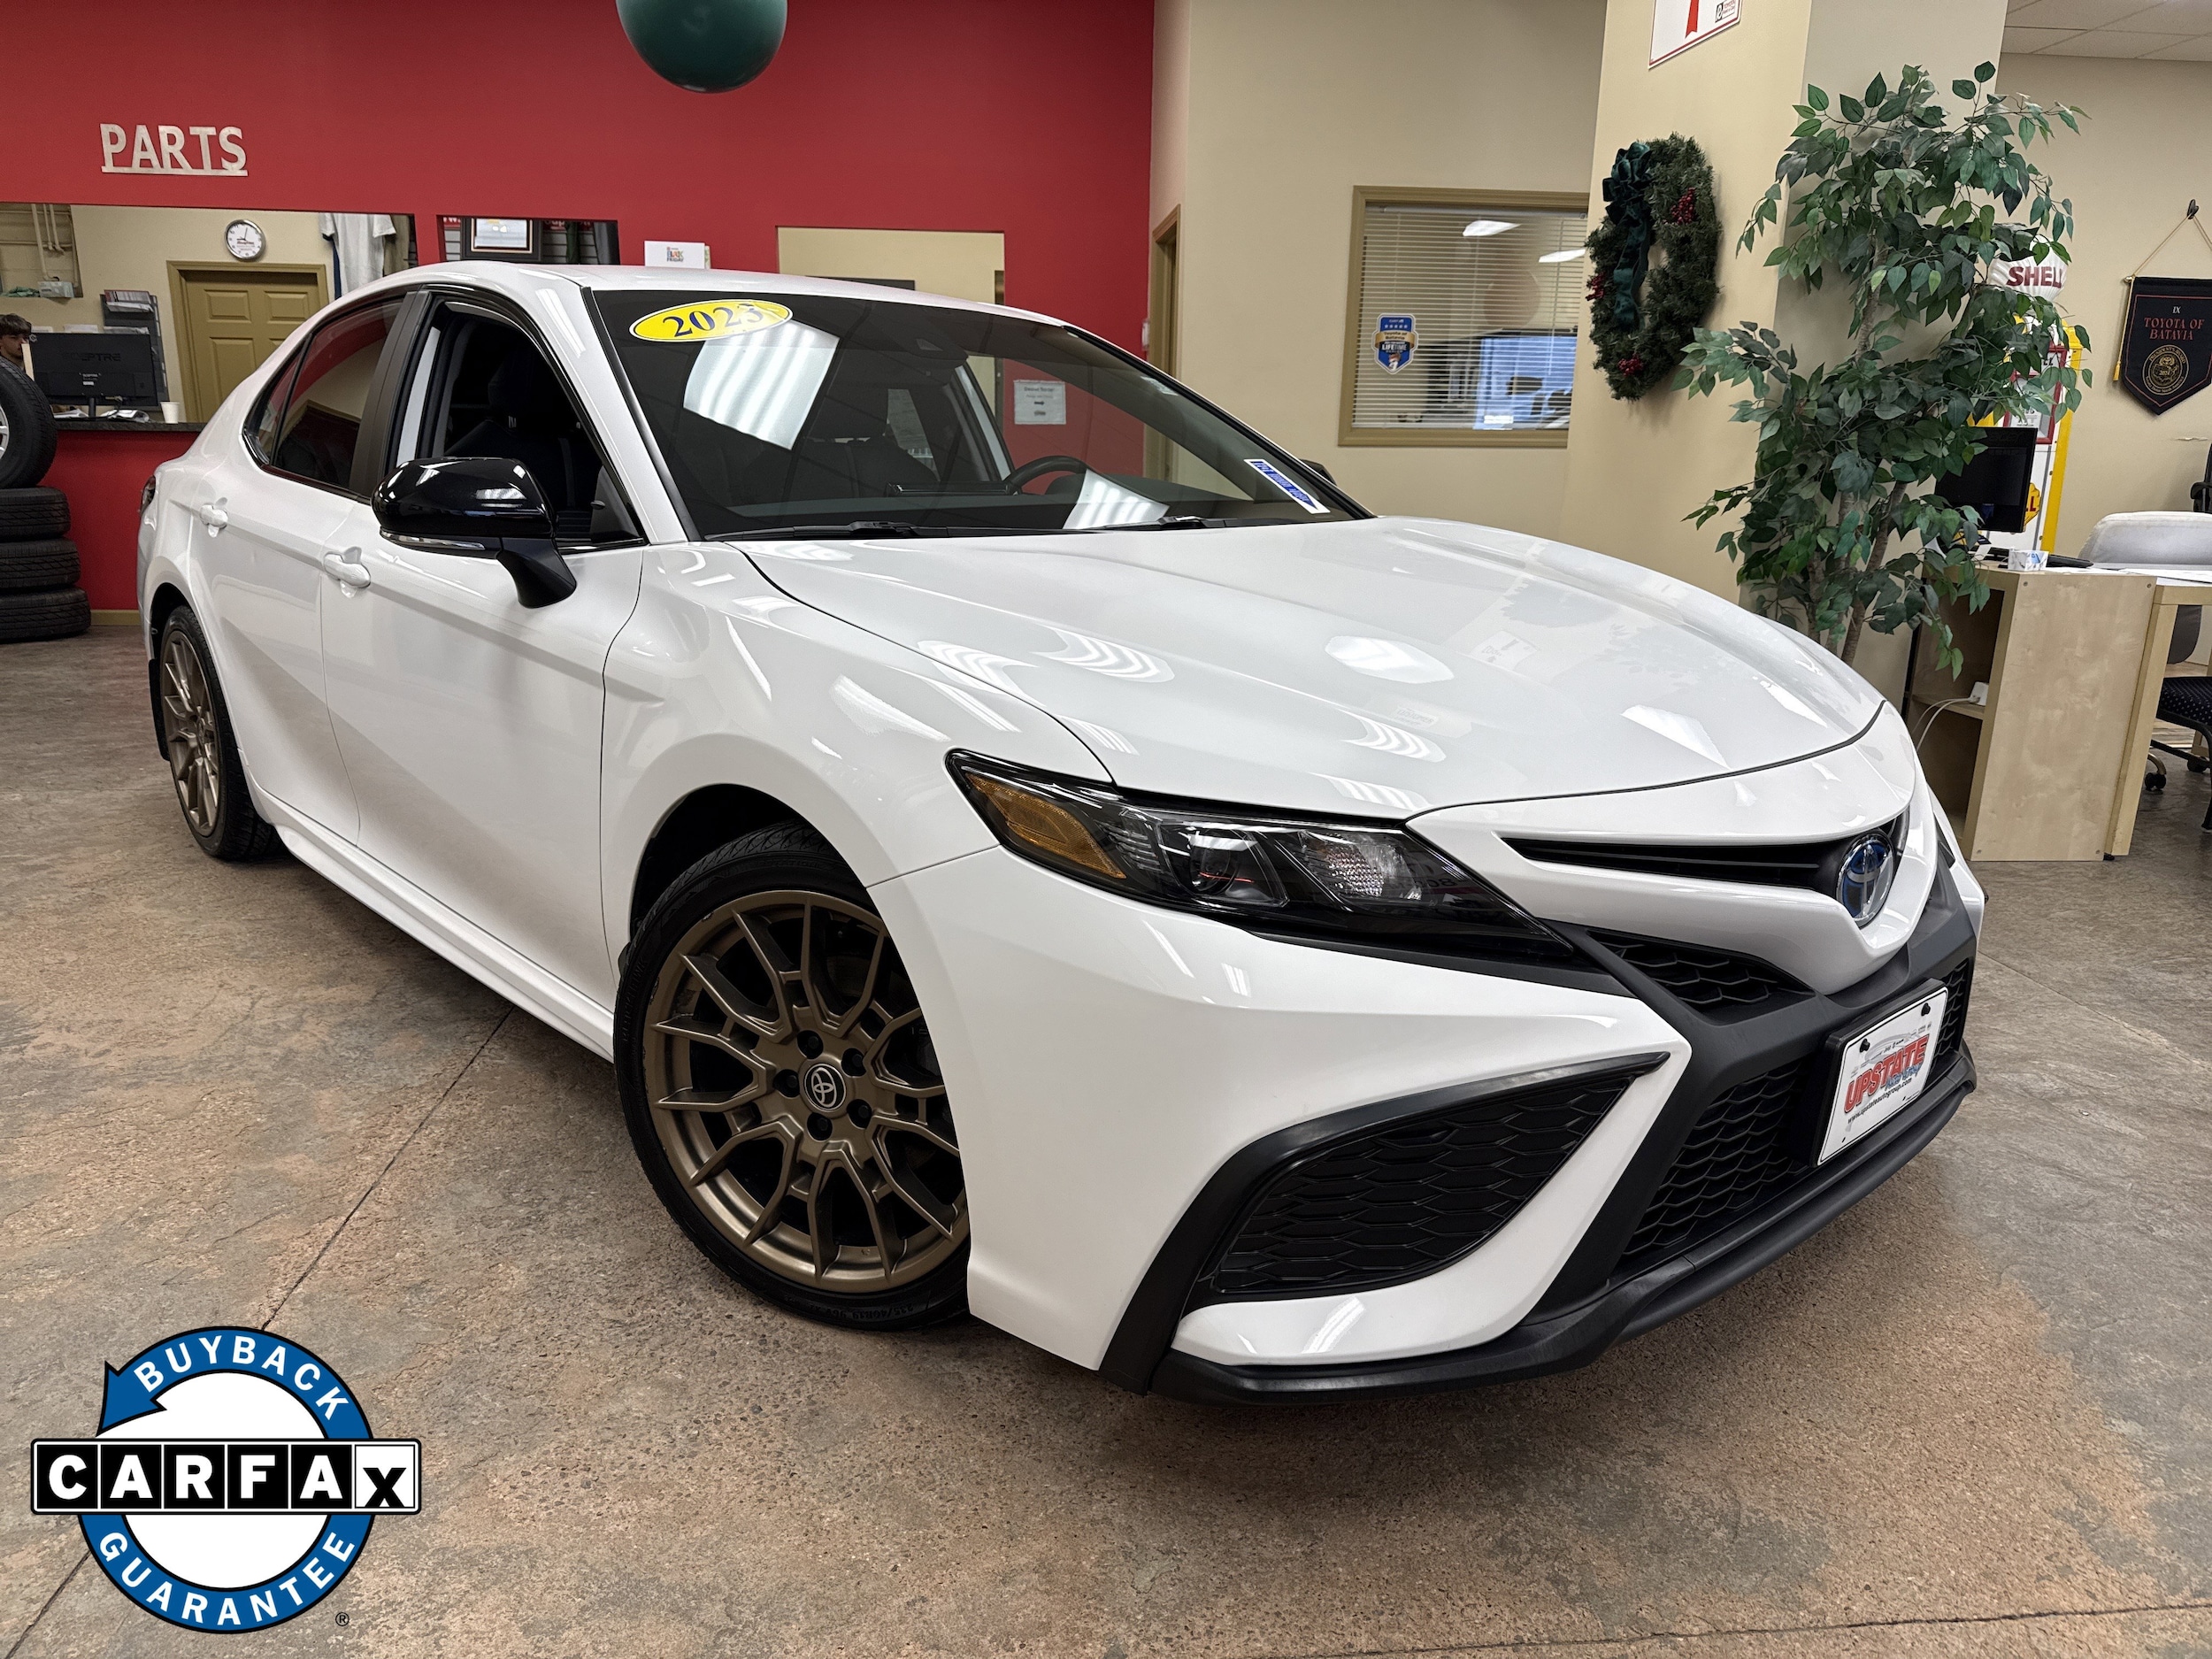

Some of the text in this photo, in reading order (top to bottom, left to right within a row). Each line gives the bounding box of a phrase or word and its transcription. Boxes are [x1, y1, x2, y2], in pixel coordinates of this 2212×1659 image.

[100, 123, 247, 171] PARTS
[663, 303, 764, 337] 2023
[2144, 318, 2204, 329] TOYOTA OF
[2149, 329, 2193, 340] BATAVIA
[1844, 1033, 1930, 1114] UPSTATE
[1847, 1077, 1912, 1125] www.upstateautogroup.com
